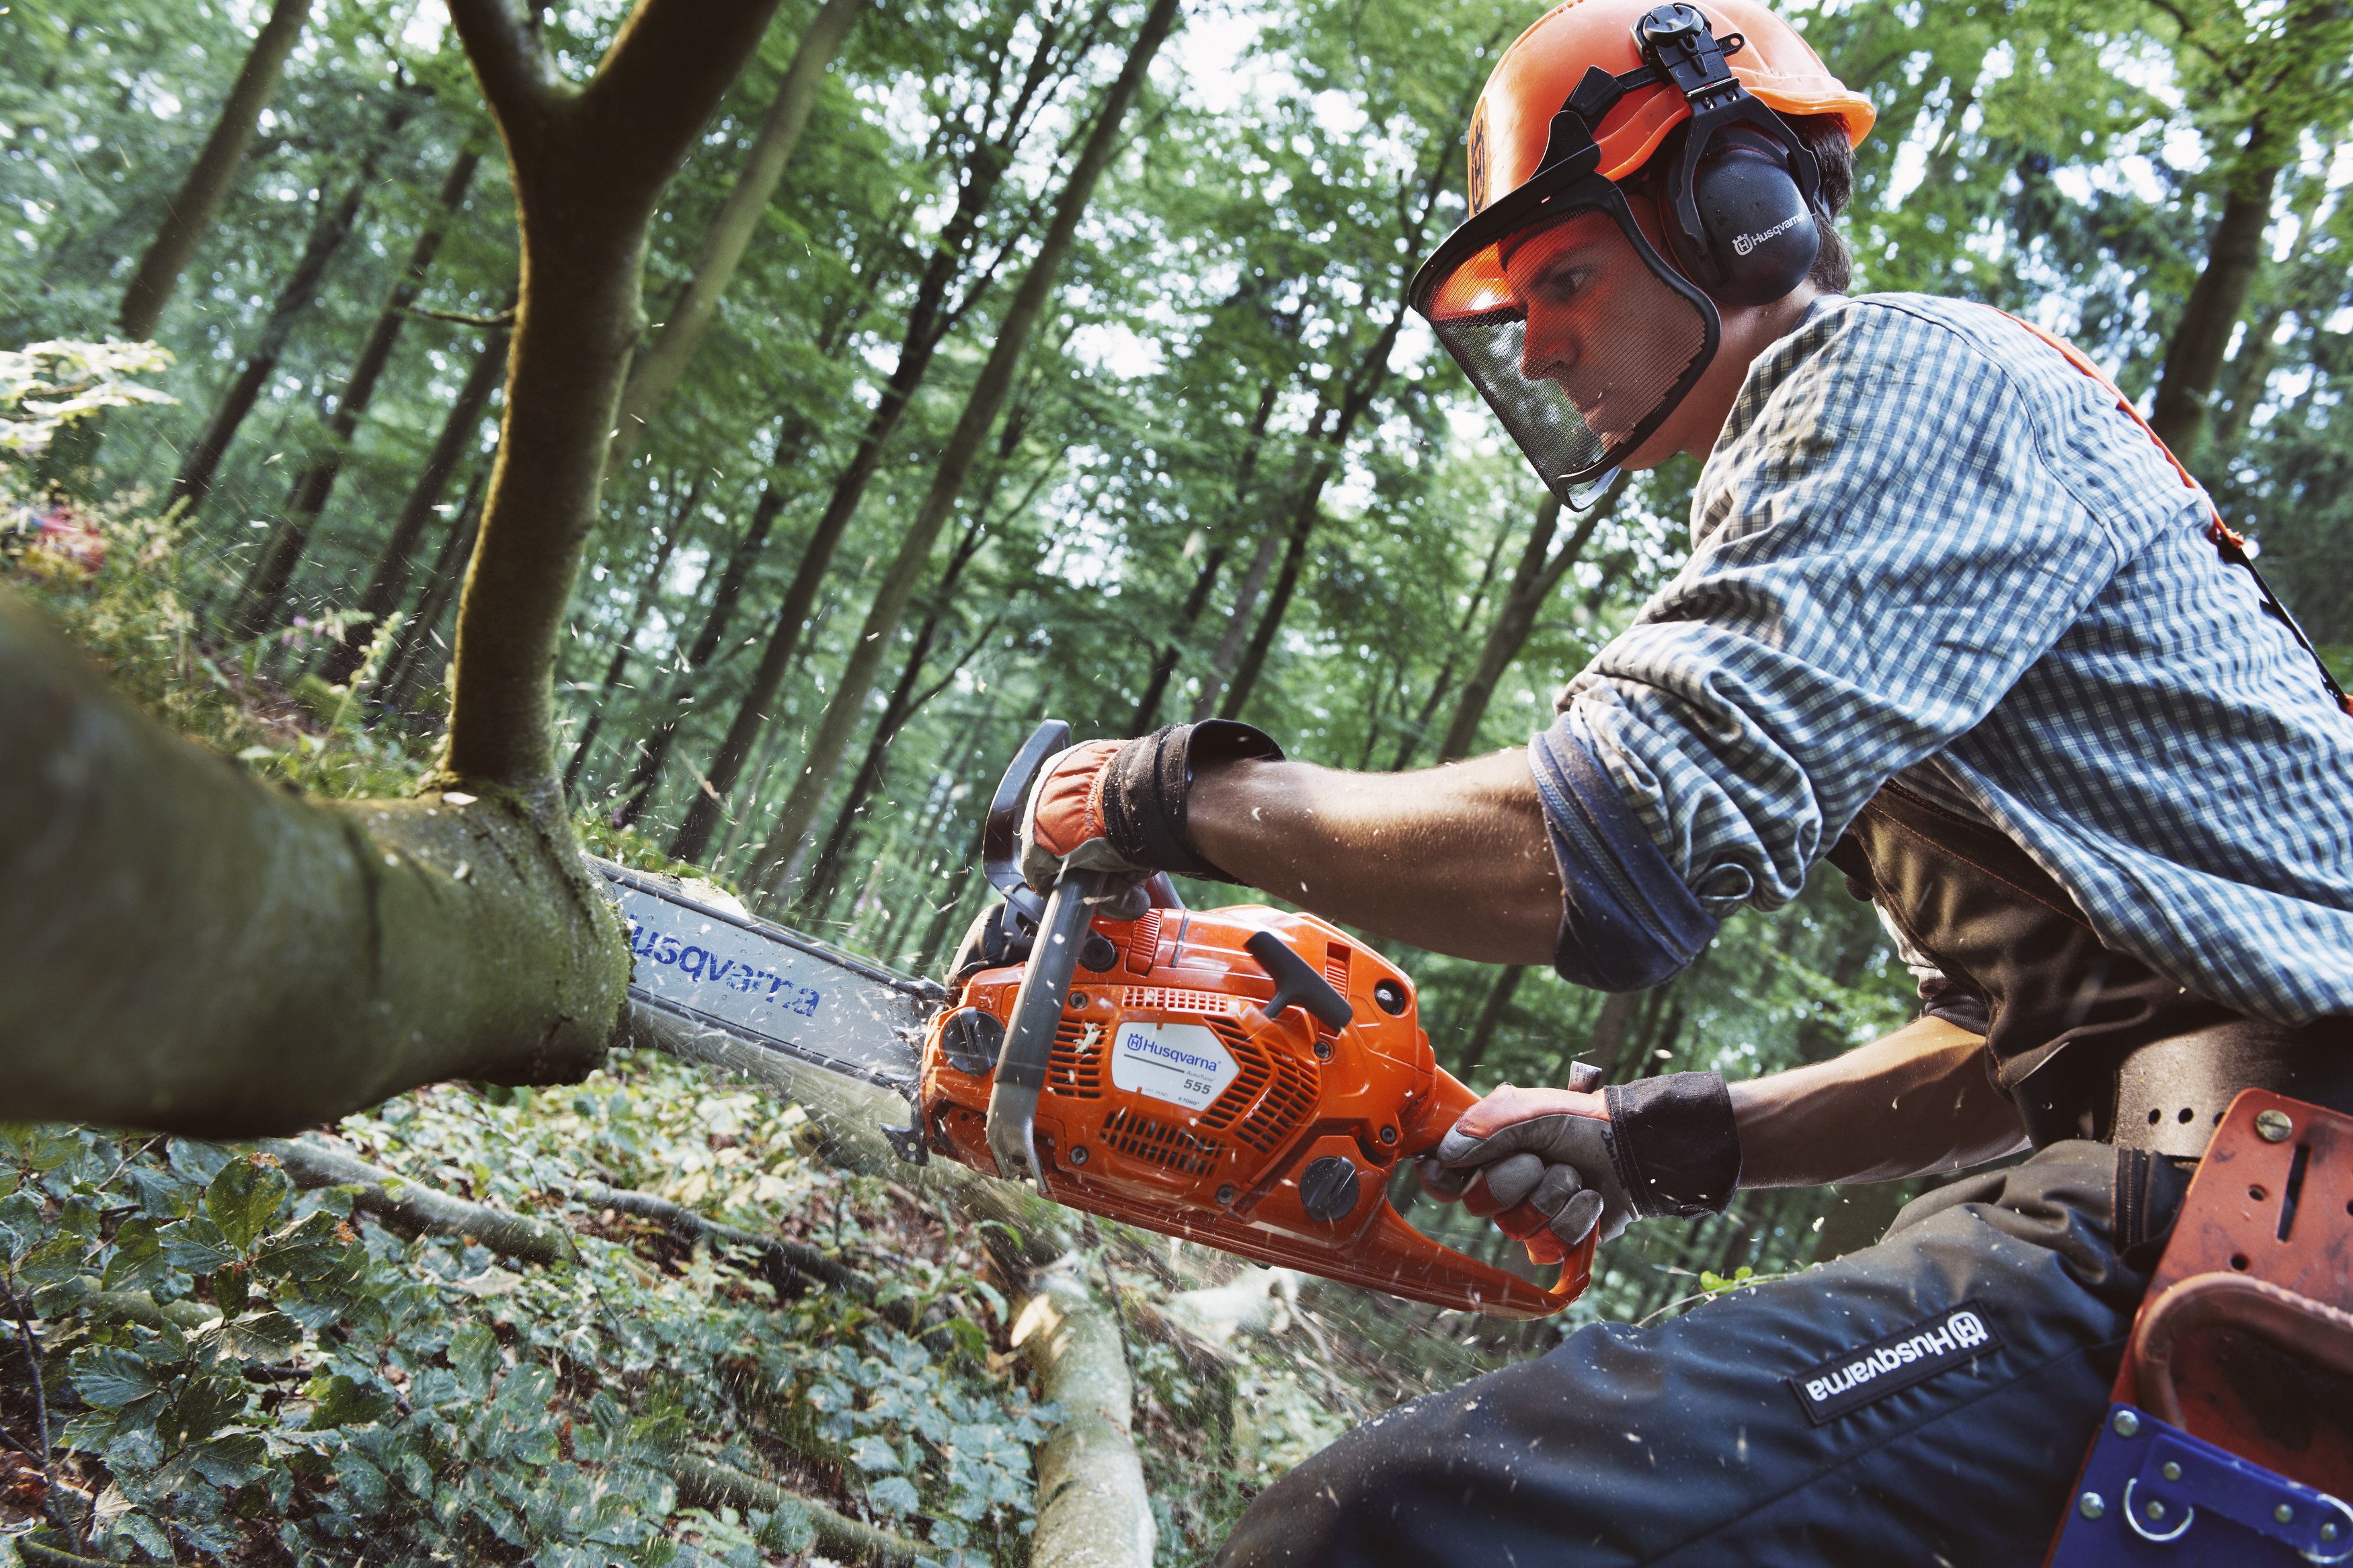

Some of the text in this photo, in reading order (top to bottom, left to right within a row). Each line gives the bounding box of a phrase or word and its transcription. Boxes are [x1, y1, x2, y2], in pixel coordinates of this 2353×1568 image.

[1751, 212, 1804, 246] Husqvarna
[630, 913, 820, 1018] usqvarna
[1143, 1039, 1218, 1072] Husqvarna
[1183, 1079, 1211, 1095] 555
[1805, 1326, 1957, 1401] Husqvarna
